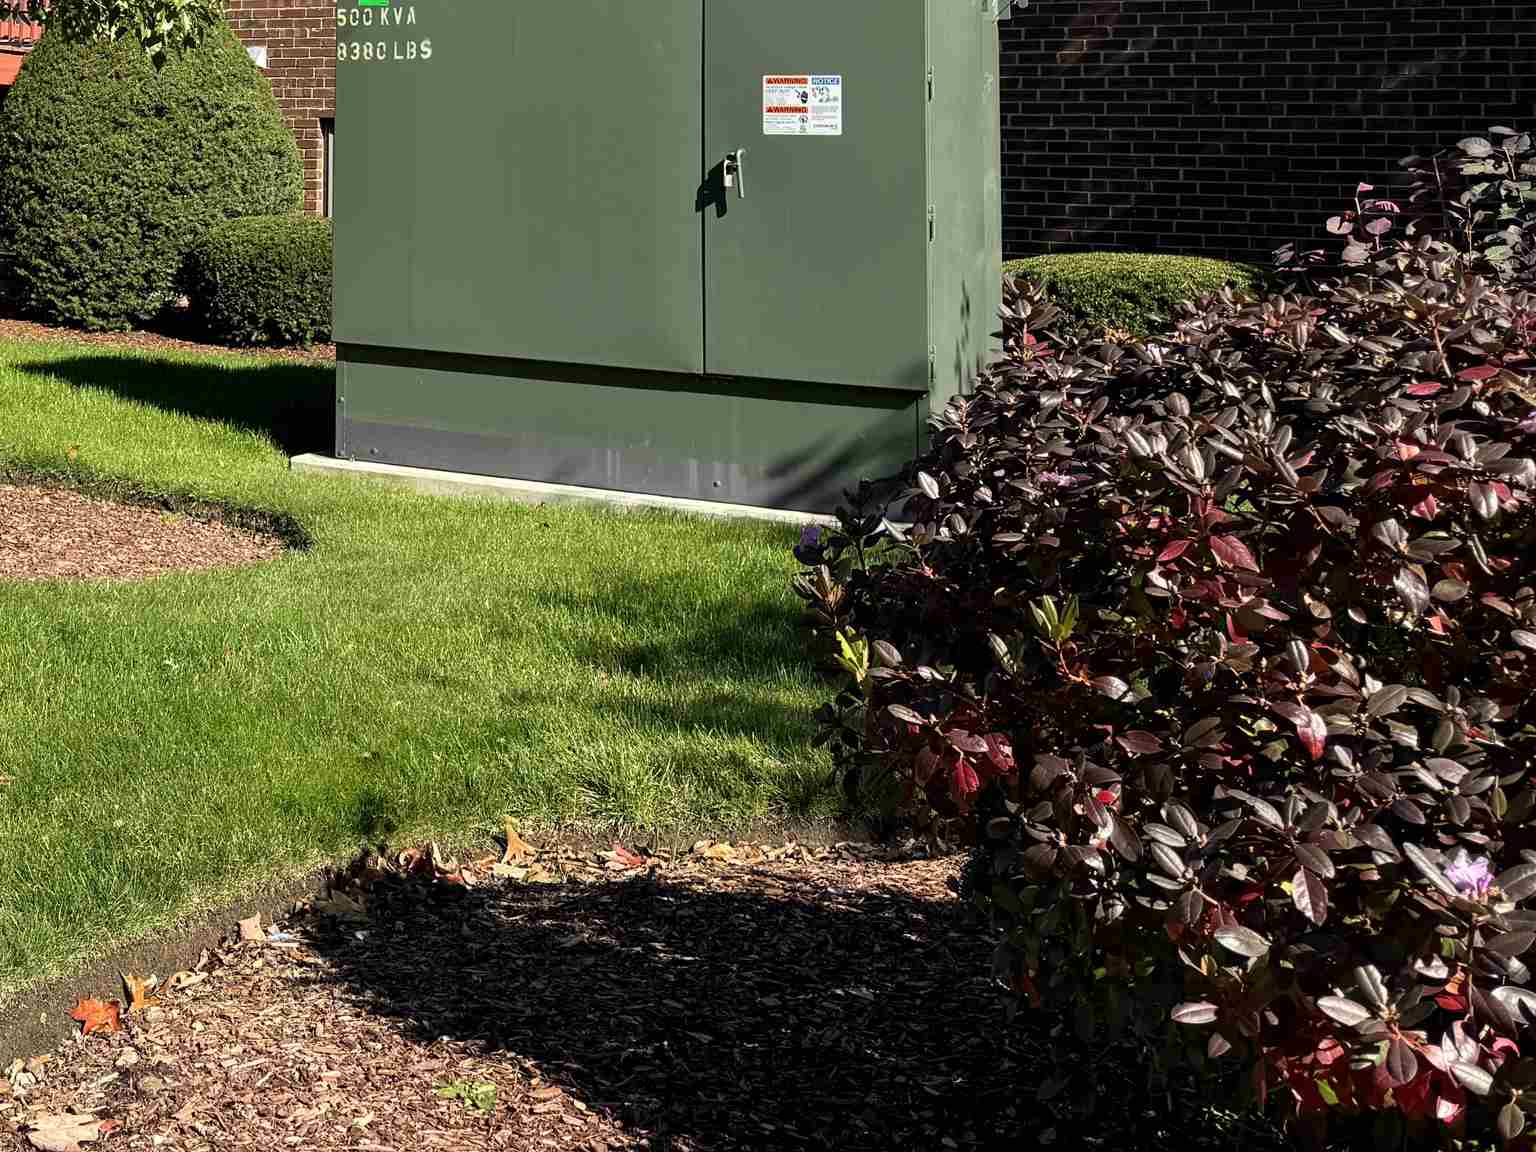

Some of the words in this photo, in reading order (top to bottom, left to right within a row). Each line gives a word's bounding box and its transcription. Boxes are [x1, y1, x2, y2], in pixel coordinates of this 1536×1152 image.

[337, 8, 373, 26] 500
[380, 6, 416, 25] KVA
[337, 42, 387, 60] 8380
[393, 40, 432, 59] LBS
